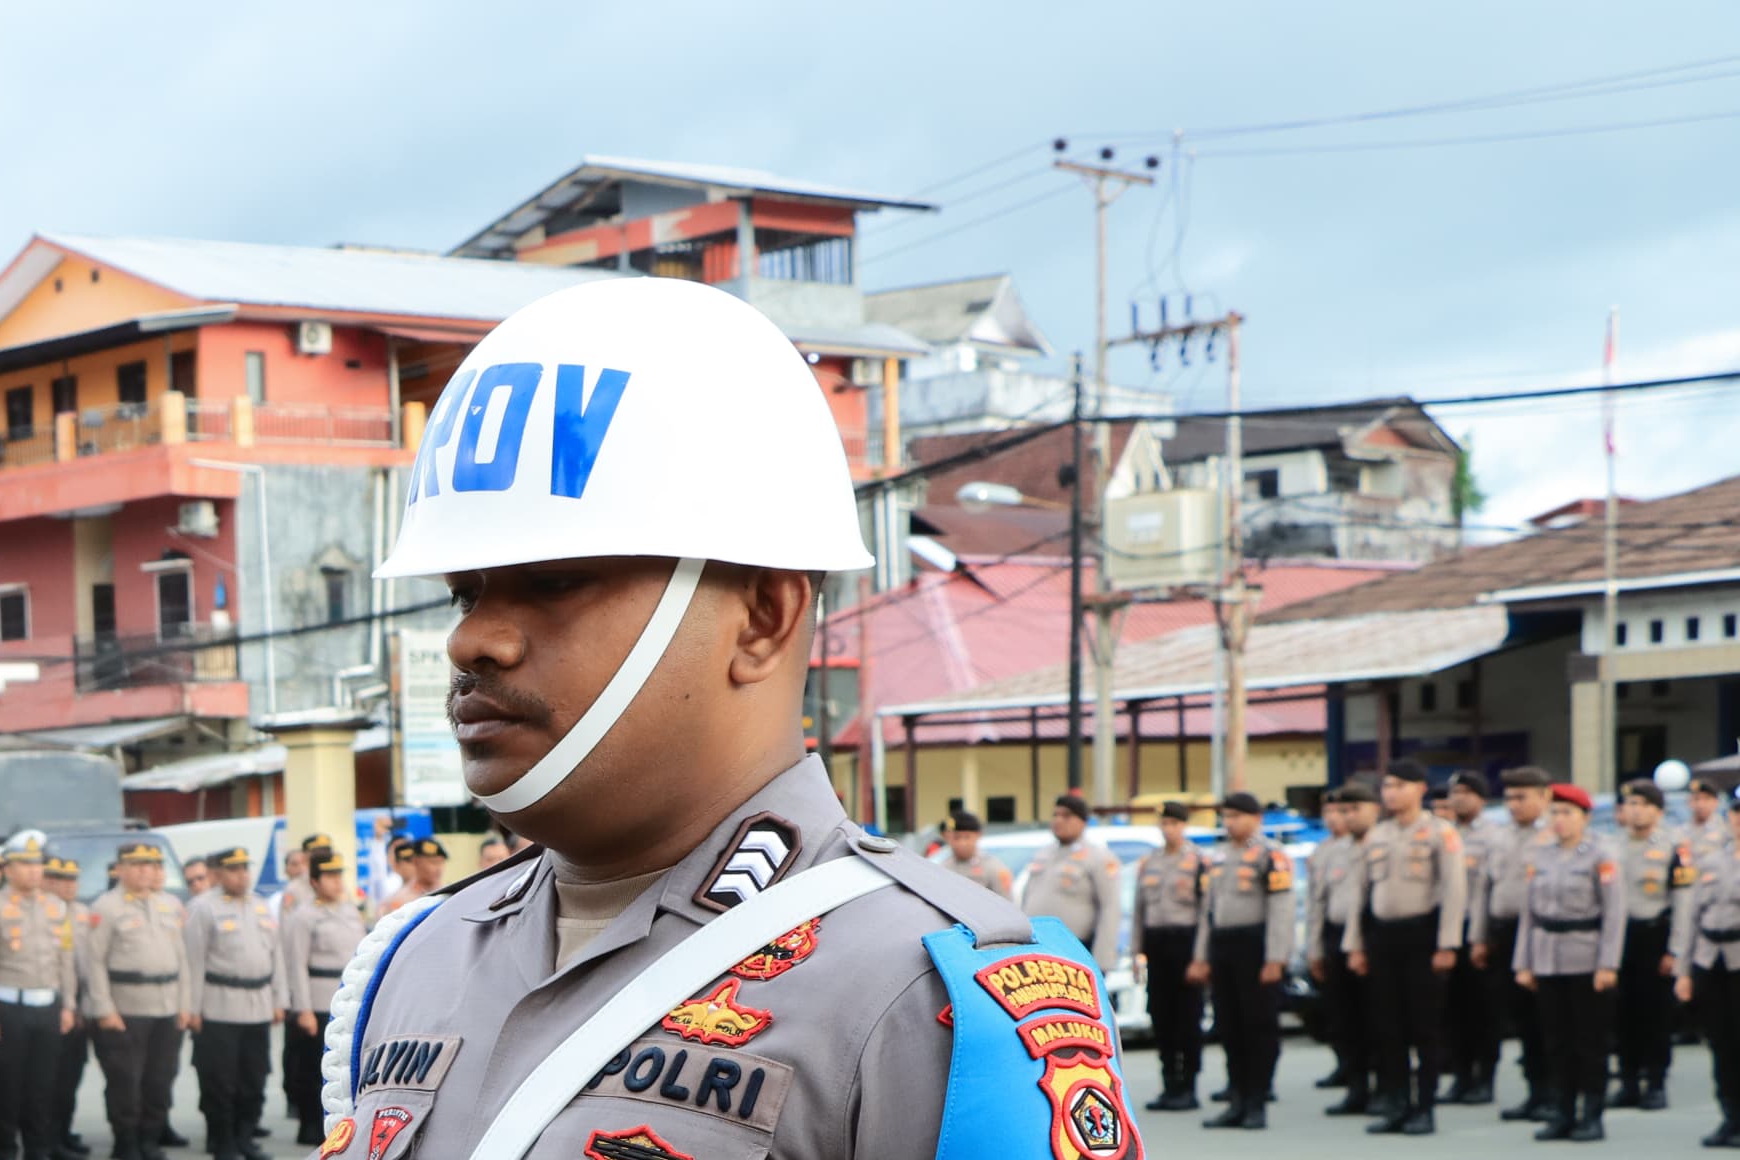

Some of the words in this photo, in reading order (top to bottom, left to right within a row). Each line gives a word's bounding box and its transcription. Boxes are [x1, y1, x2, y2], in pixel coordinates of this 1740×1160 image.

[987, 959, 1093, 997] POLRESTA
[1031, 1022, 1105, 1047] MALUKU
[586, 1046, 766, 1119] POLRI
